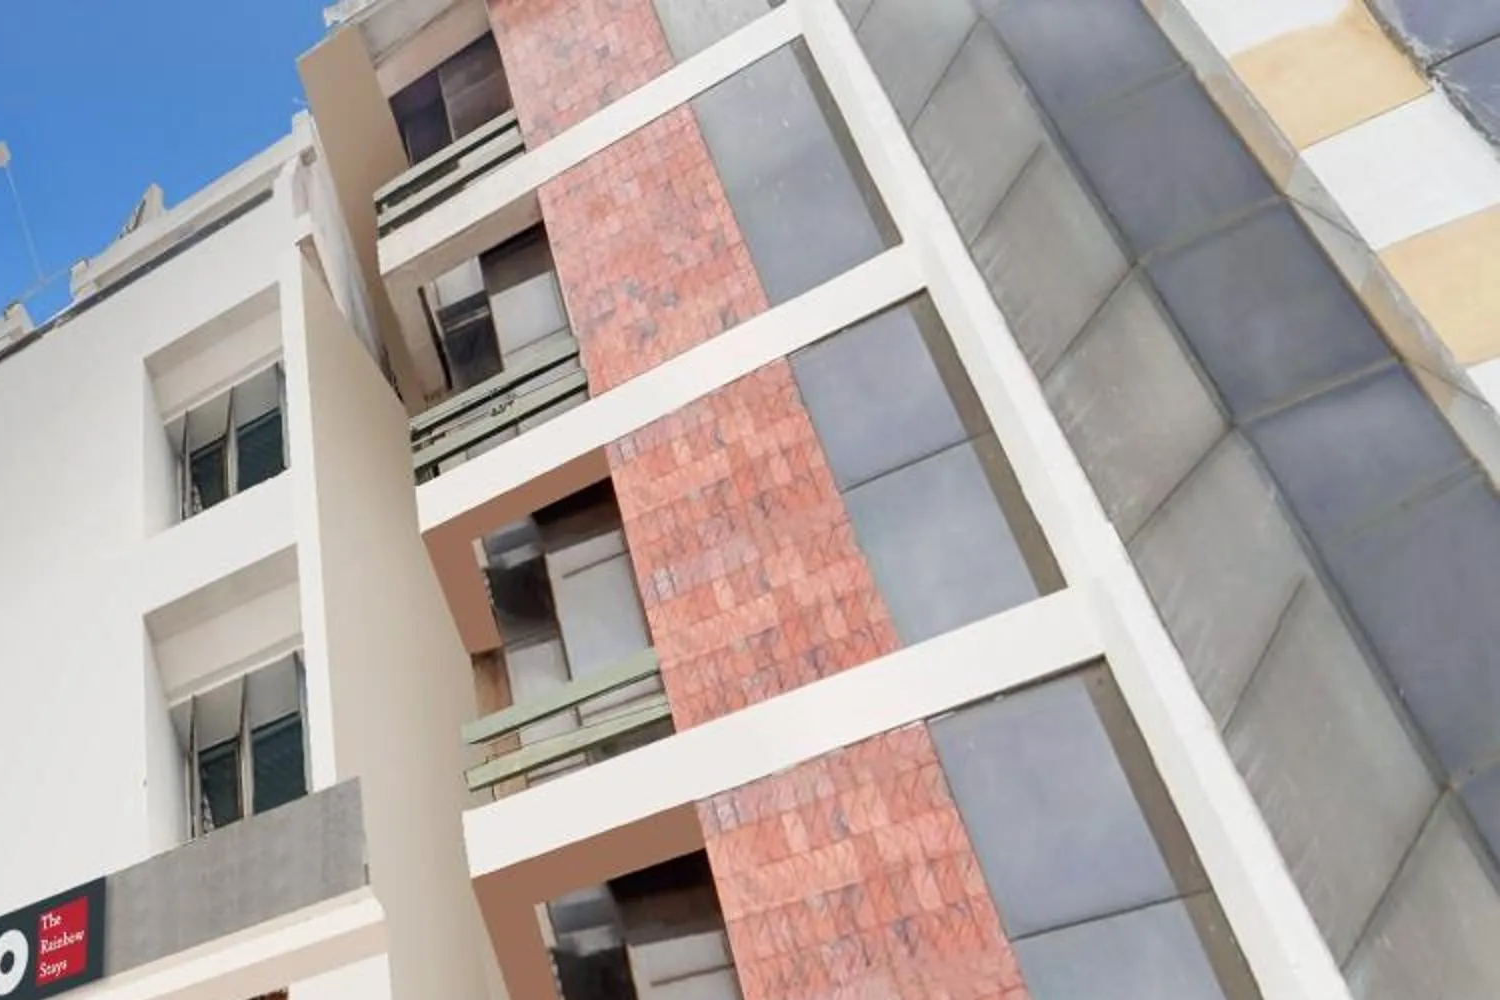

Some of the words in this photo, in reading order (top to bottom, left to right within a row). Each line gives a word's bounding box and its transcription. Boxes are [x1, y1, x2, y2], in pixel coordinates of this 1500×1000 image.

[41, 913, 62, 930] The
[40, 929, 86, 955] Rainbow
[39, 958, 68, 979] Stays
